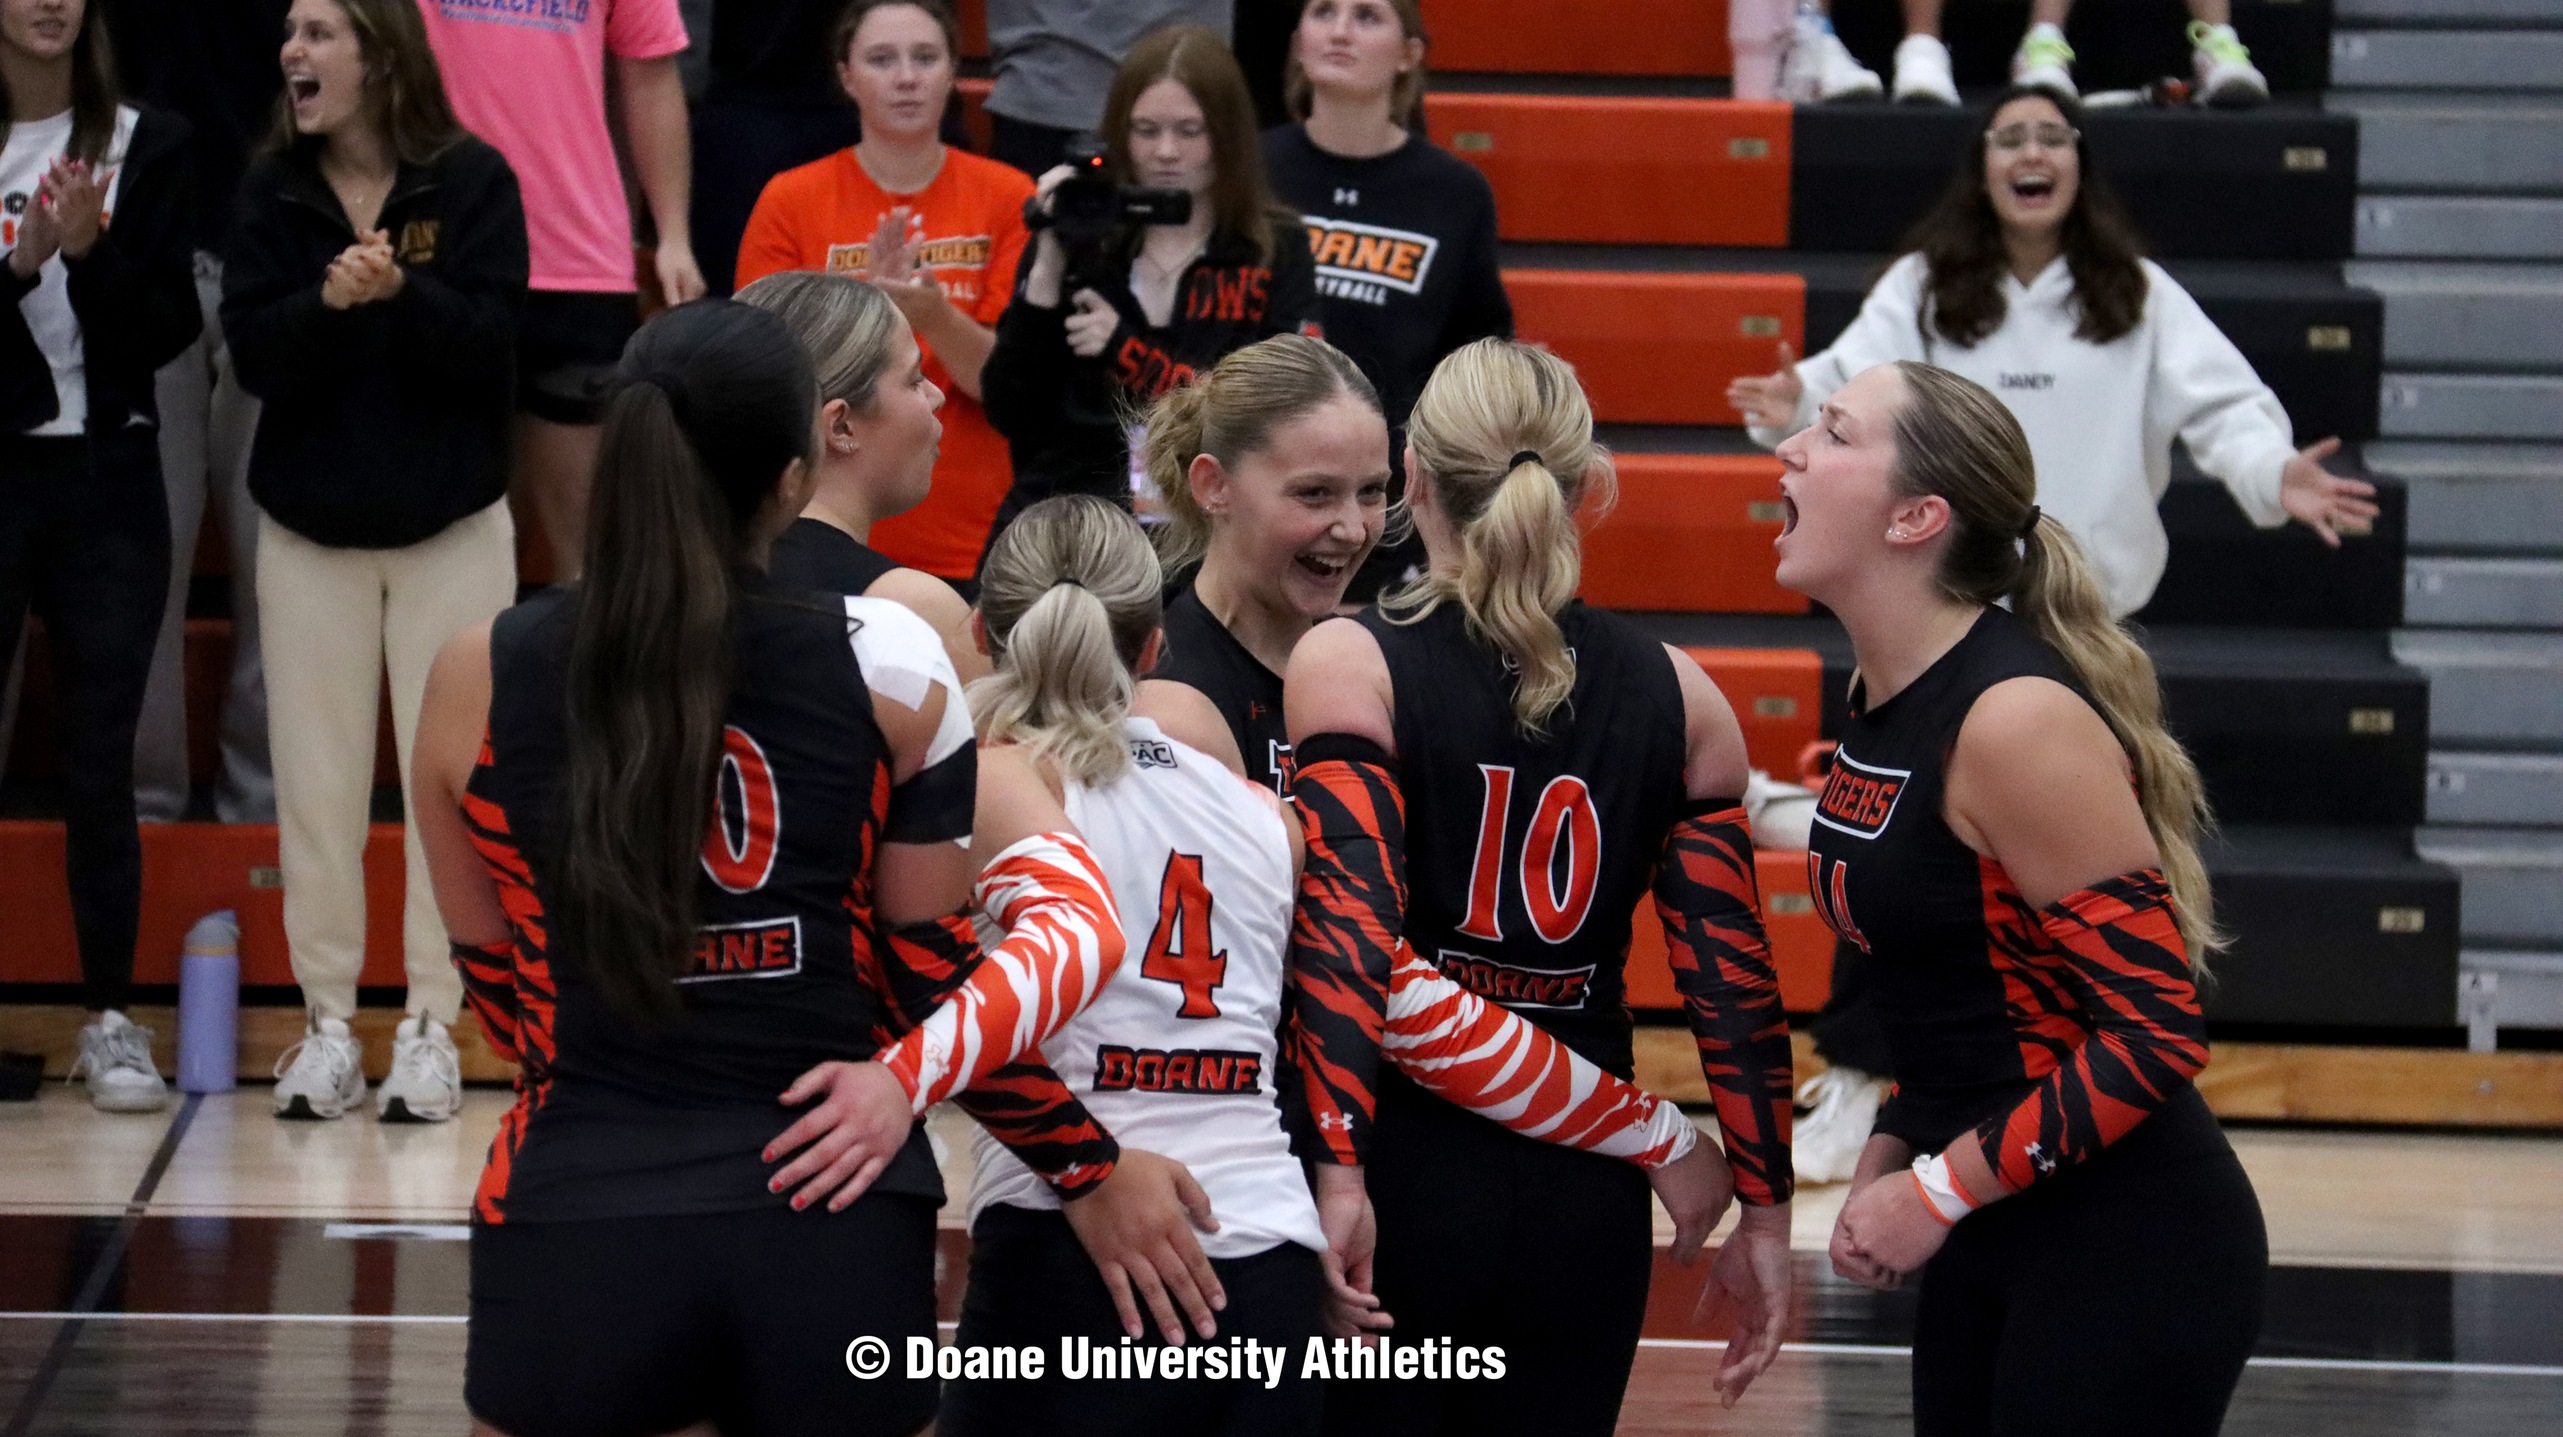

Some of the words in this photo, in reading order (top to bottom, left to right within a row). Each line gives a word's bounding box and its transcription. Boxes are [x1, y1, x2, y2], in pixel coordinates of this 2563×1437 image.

[1308, 227, 1426, 281] ANE
[1453, 762, 1602, 945] 10
[686, 929, 791, 971] ANE
[1140, 847, 1228, 1019] 4
[1097, 1047, 1261, 1093] DOANE
